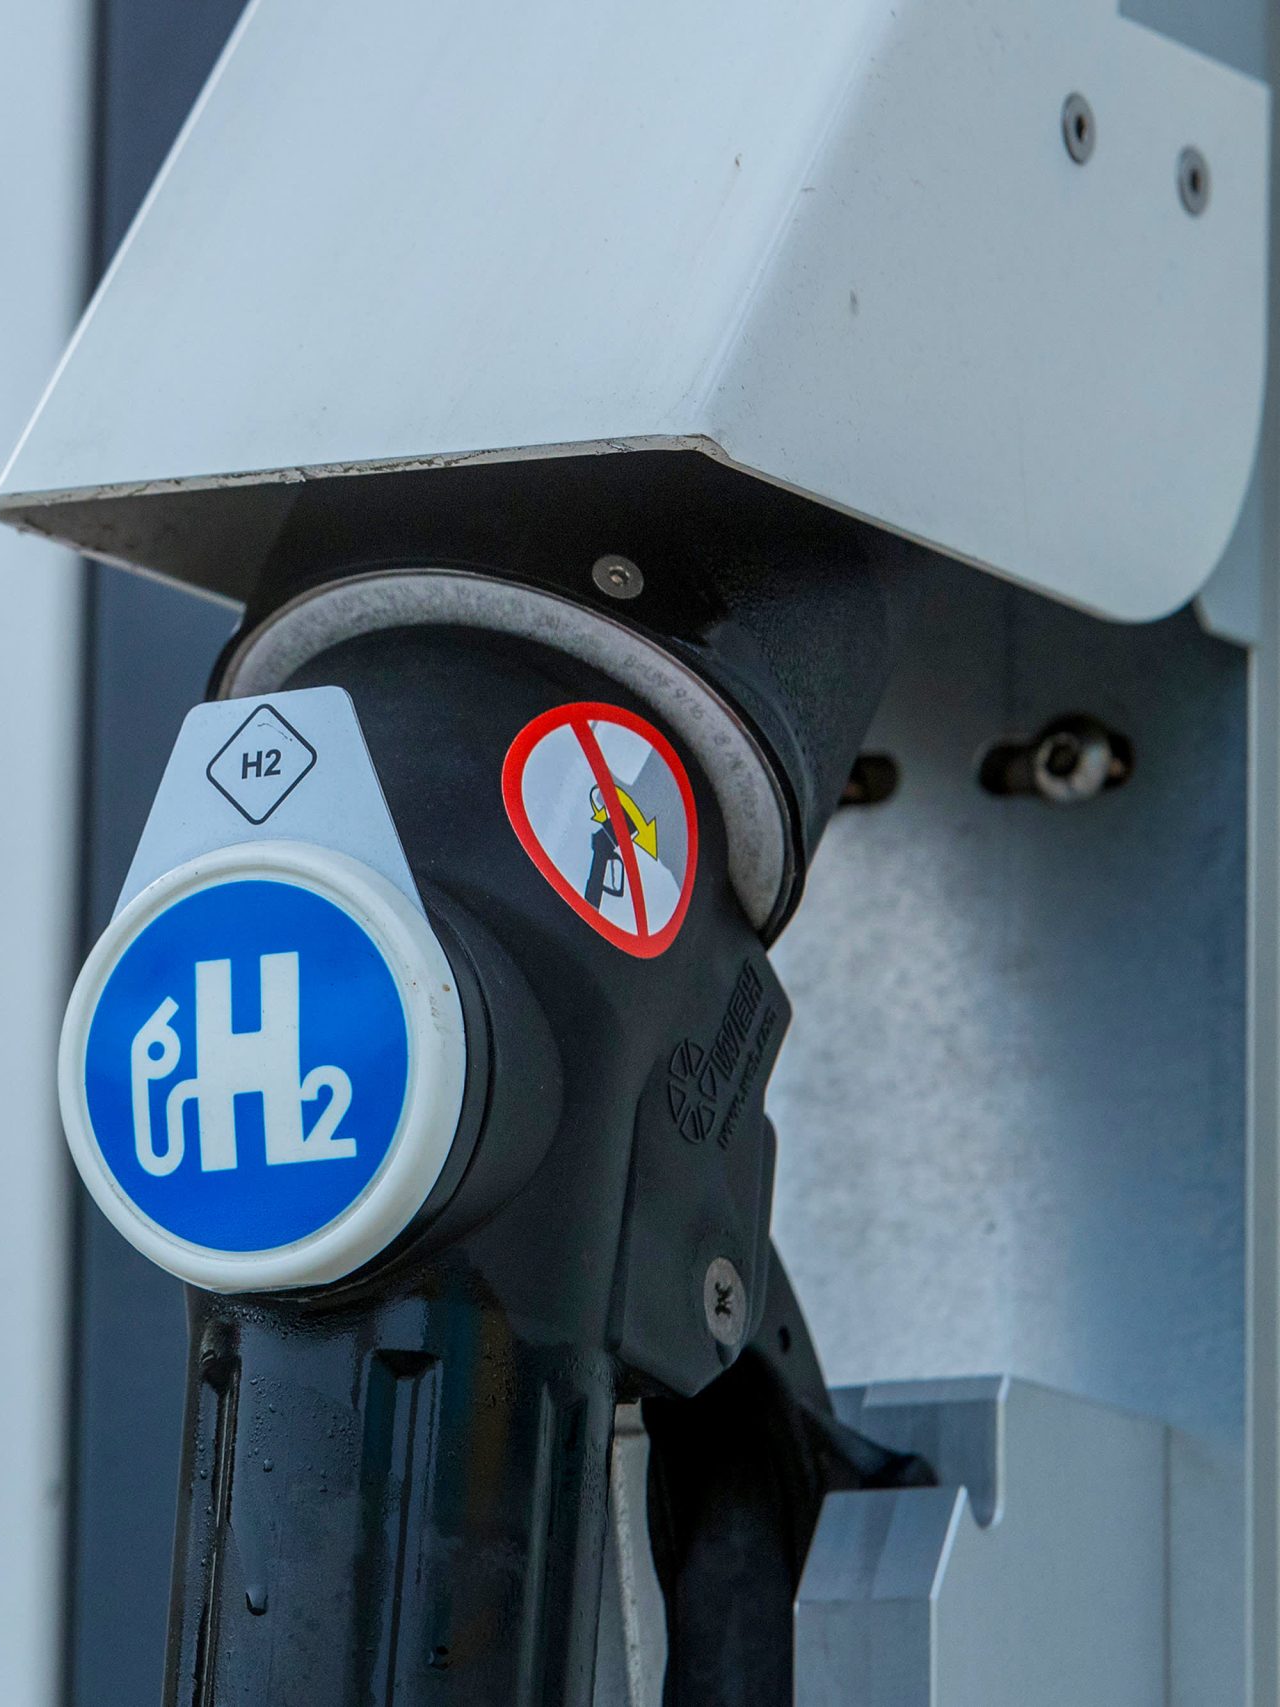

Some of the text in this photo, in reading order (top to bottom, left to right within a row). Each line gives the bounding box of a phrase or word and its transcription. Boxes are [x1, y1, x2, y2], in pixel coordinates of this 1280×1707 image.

[241, 748, 282, 780] H2
[195, 951, 357, 1172] H2
[710, 957, 765, 1082] WEH
